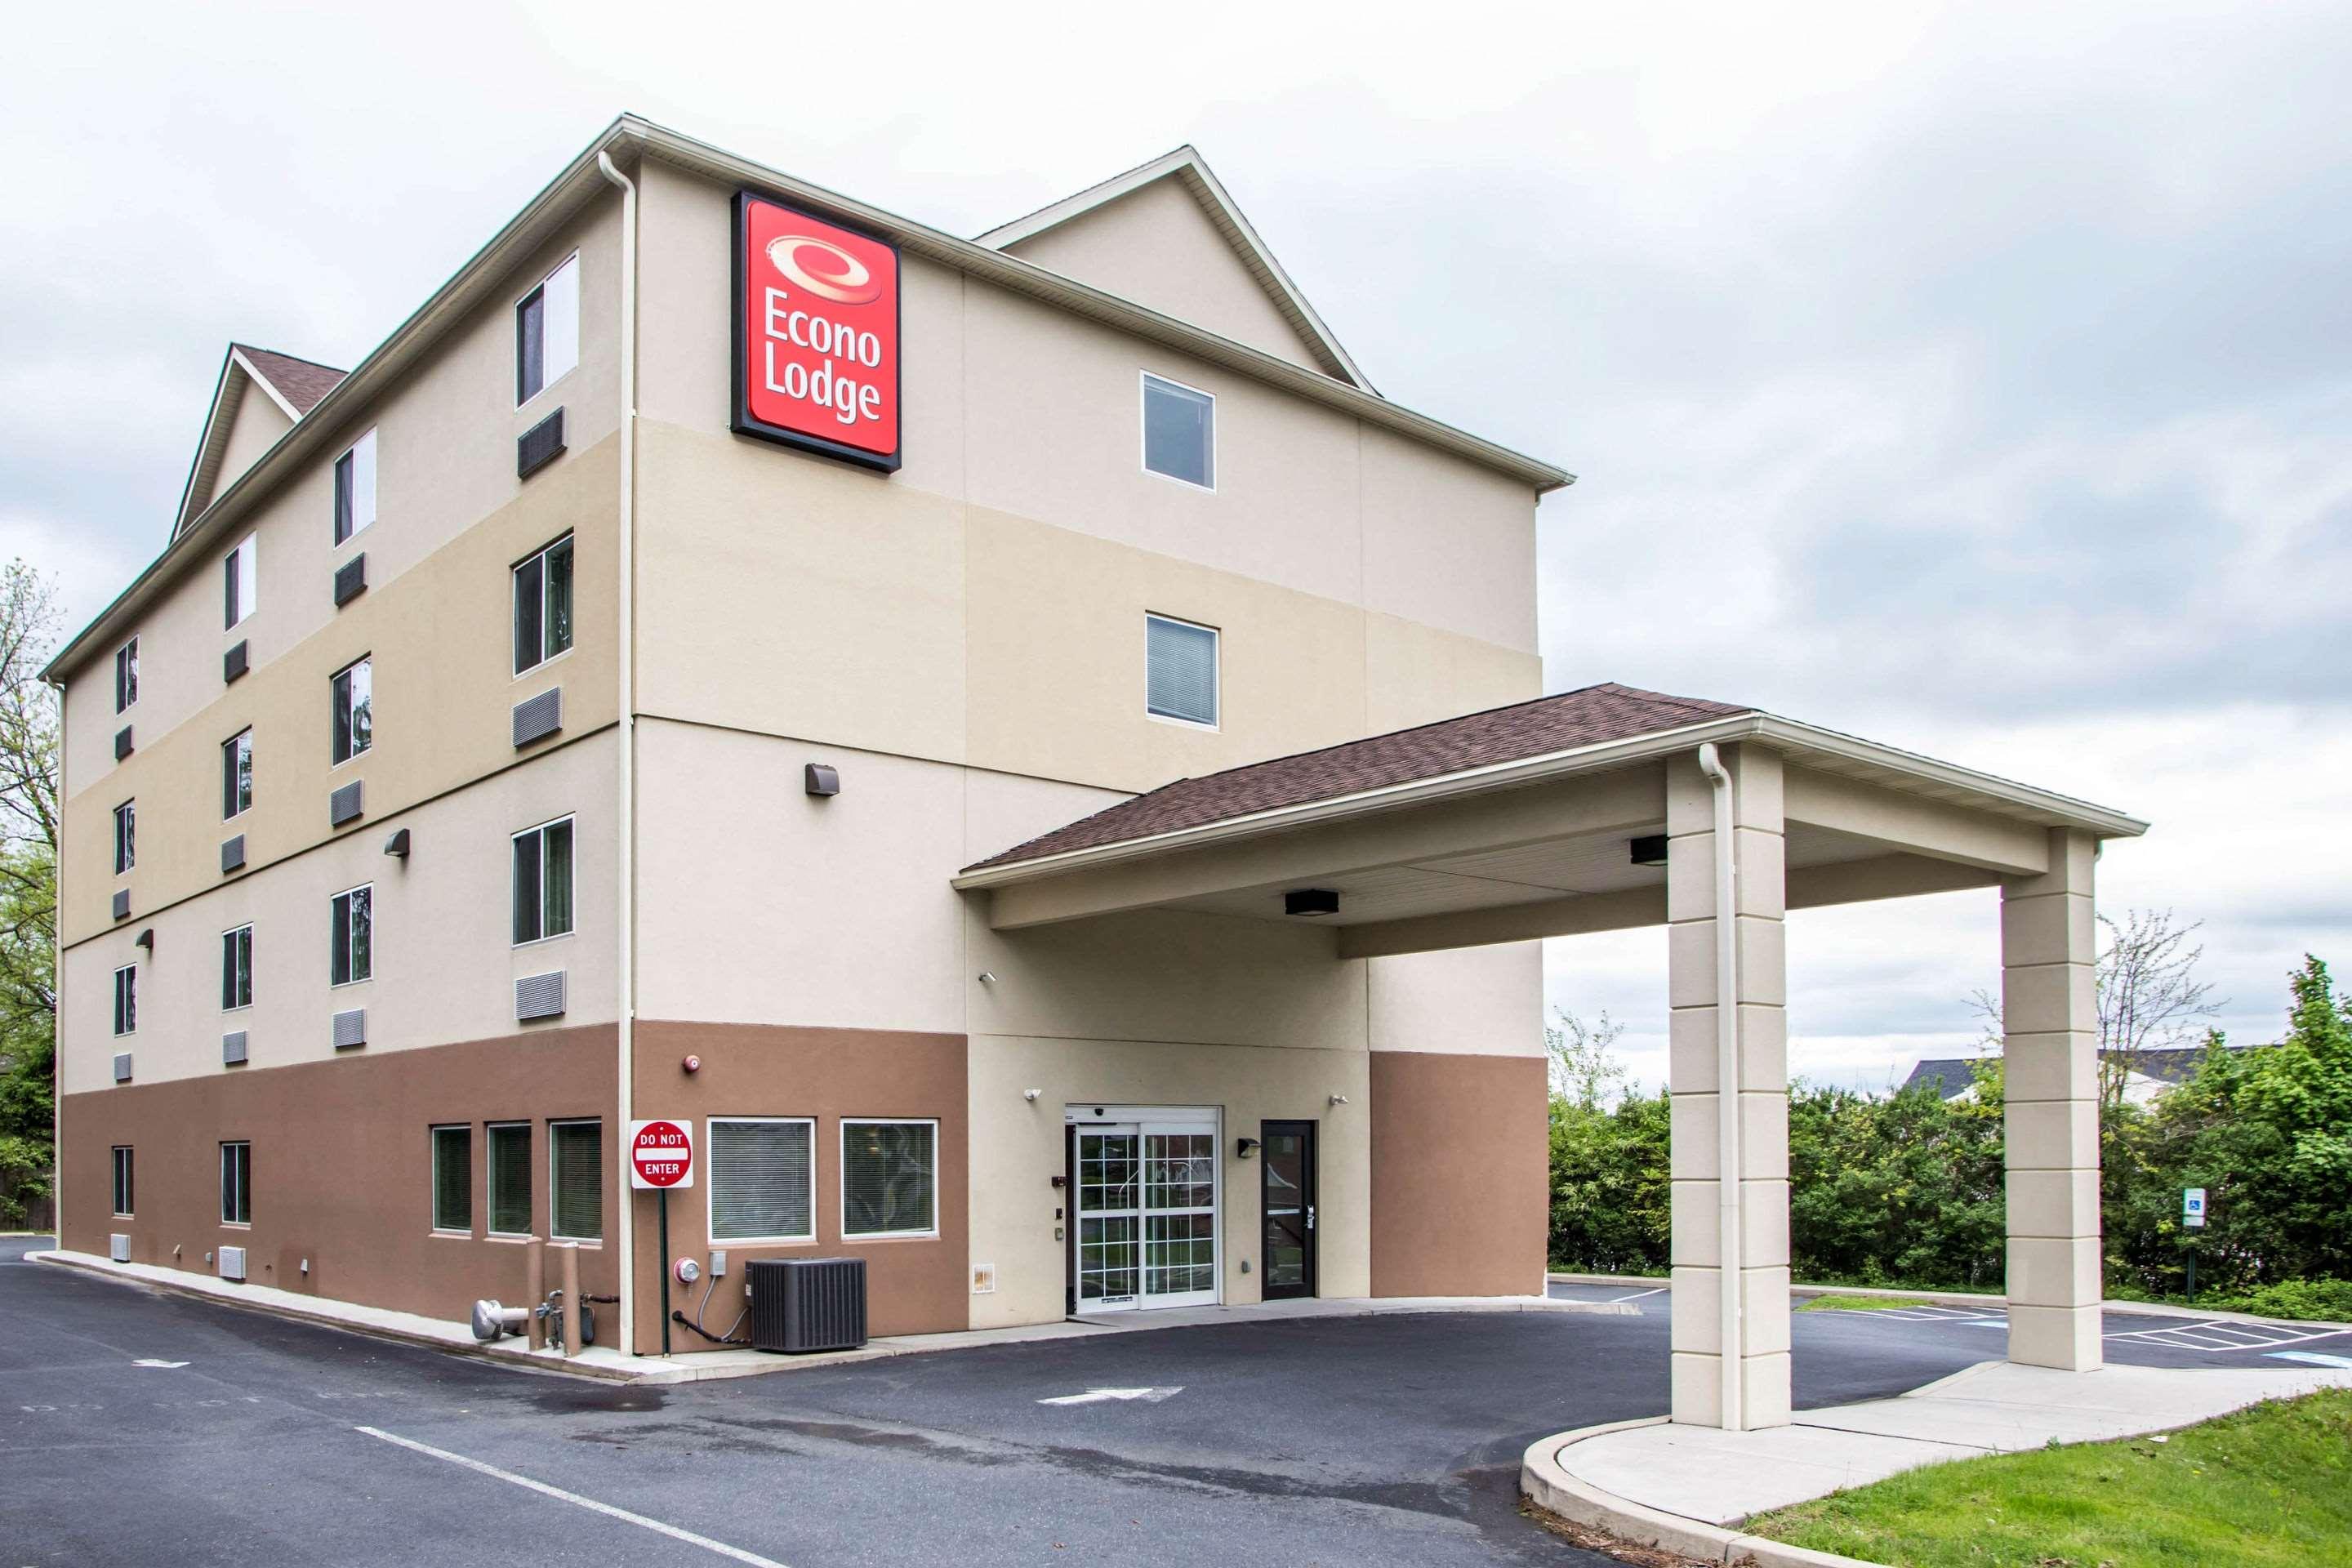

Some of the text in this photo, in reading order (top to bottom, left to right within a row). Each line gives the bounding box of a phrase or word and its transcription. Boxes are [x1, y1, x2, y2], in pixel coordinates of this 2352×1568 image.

[764, 286, 882, 368] Econo
[764, 341, 881, 425] Lodge
[640, 1134, 683, 1145] DO NOT
[645, 1163, 679, 1174] ENTER
